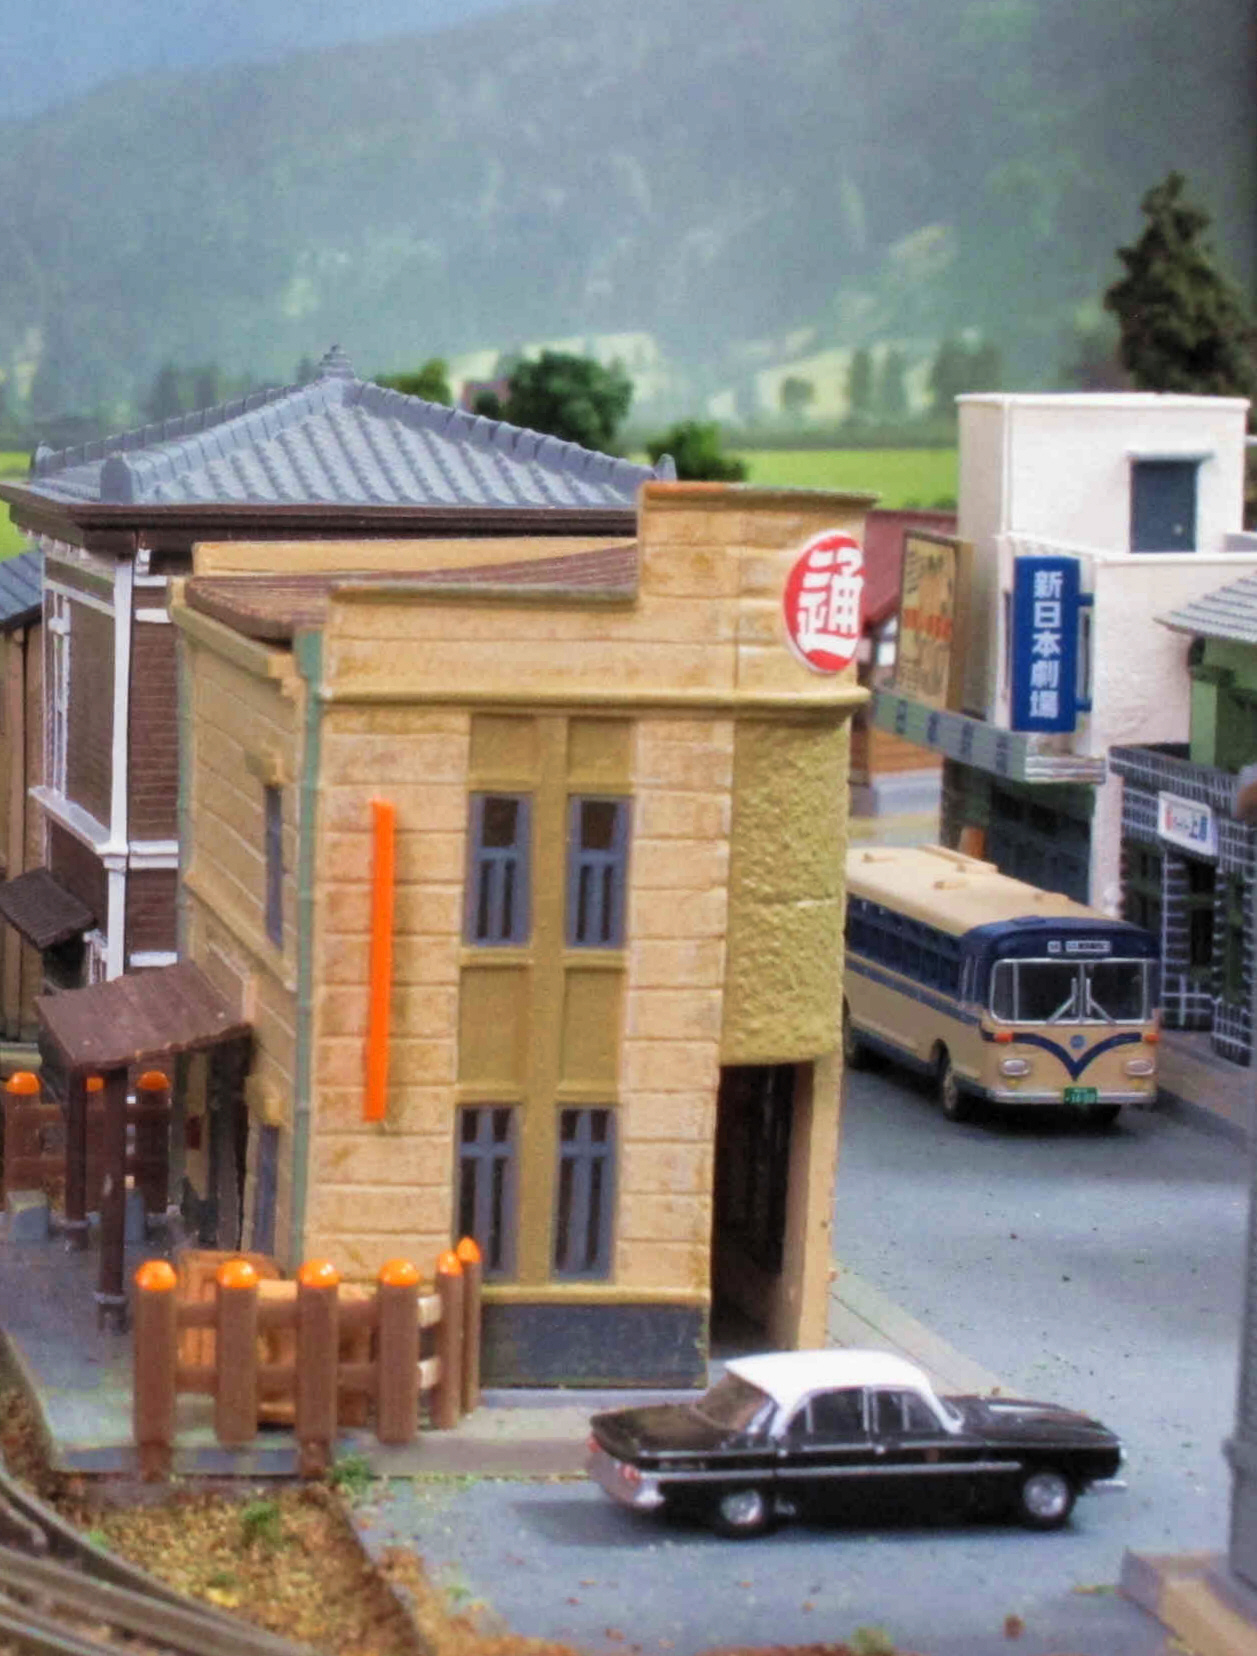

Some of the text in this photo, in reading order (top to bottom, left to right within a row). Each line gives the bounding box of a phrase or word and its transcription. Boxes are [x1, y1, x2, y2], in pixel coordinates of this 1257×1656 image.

[797, 547, 864, 657] 通
[1029, 570, 1063, 719] 新日本劇場
